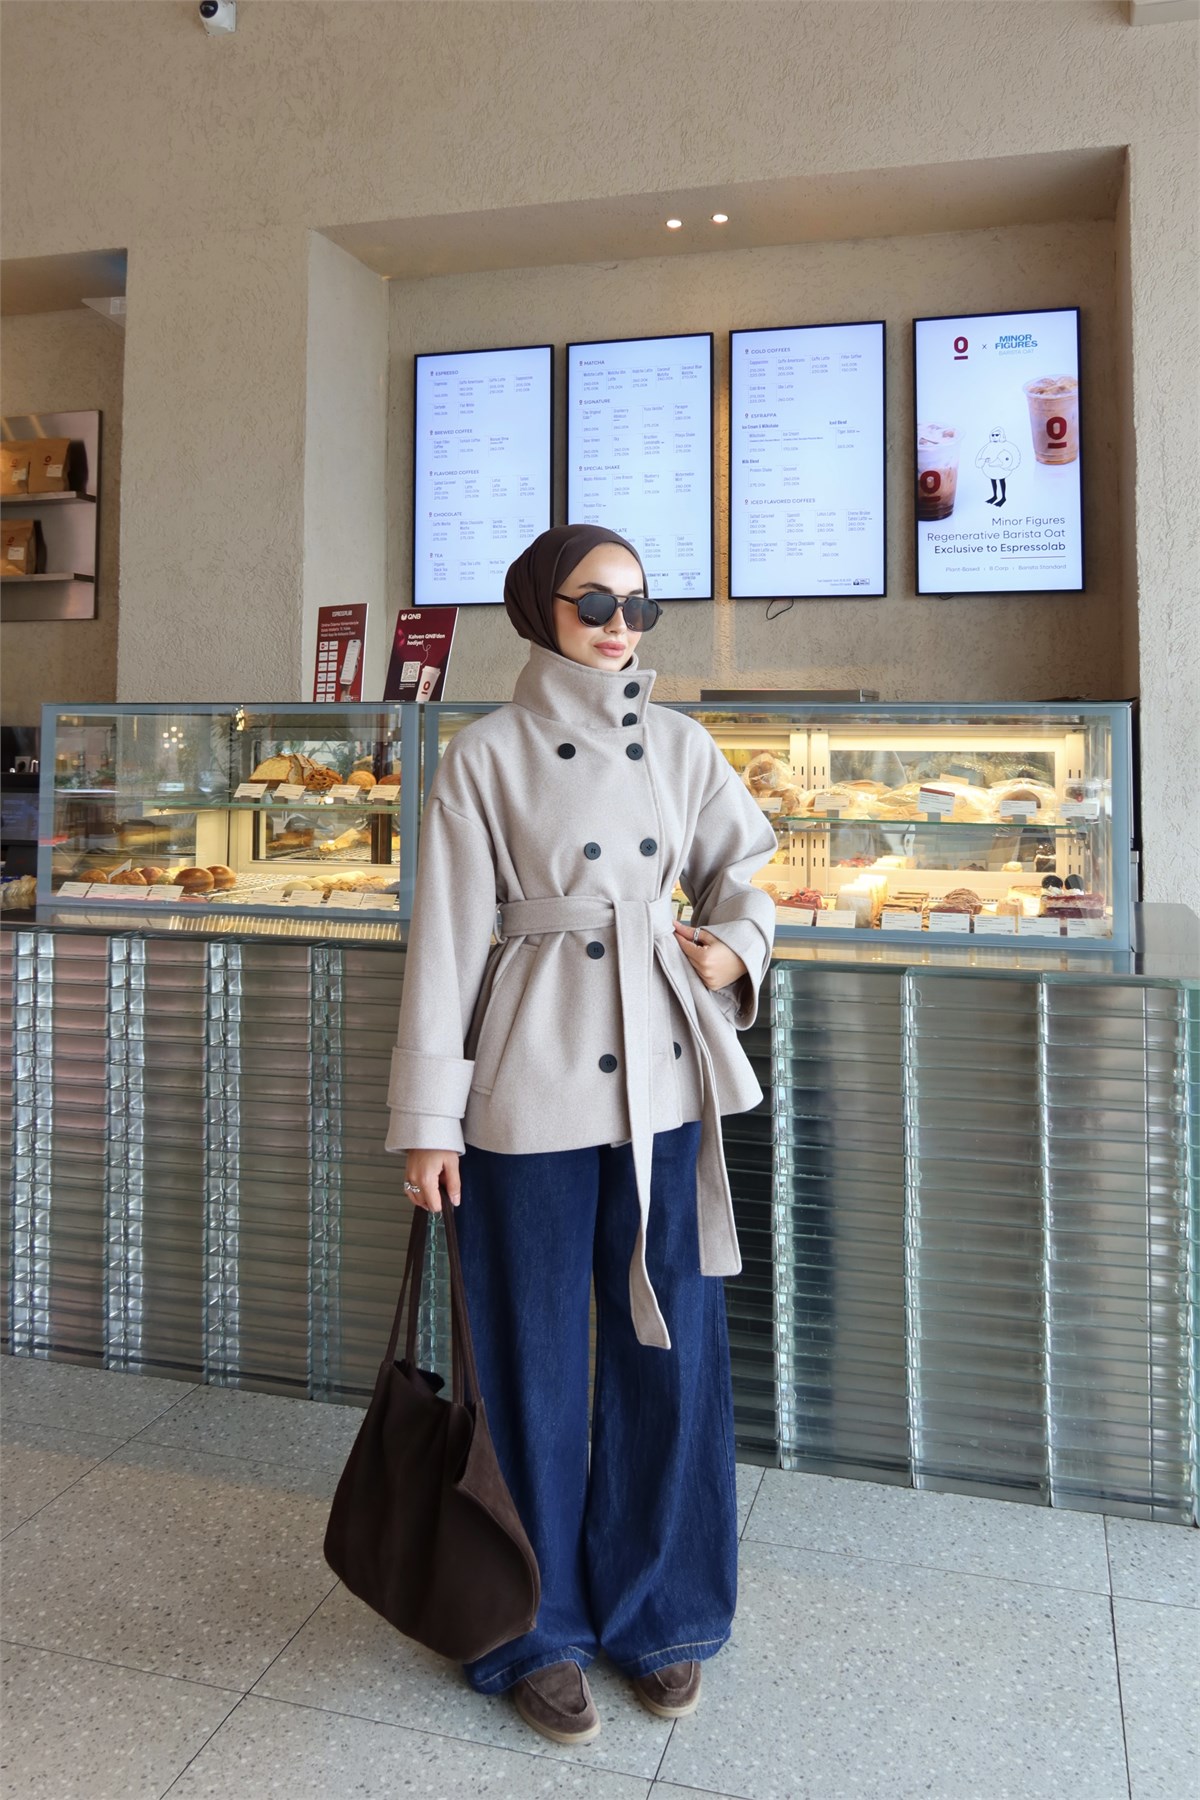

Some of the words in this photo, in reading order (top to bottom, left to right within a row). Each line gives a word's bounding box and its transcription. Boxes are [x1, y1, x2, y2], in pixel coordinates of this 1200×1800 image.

[999, 334, 1032, 343] MINOR
[995, 340, 1038, 350] FIGURES
[992, 518, 1023, 527] Minor
[1026, 516, 1066, 527] Figures
[927, 531, 1000, 543] Regenerative
[1003, 529, 1042, 539] Barista
[1044, 528, 1066, 538] Oat
[934, 544, 984, 554] Exclusive
[986, 544, 998, 553] to
[1000, 542, 1066, 554] Espressolab
